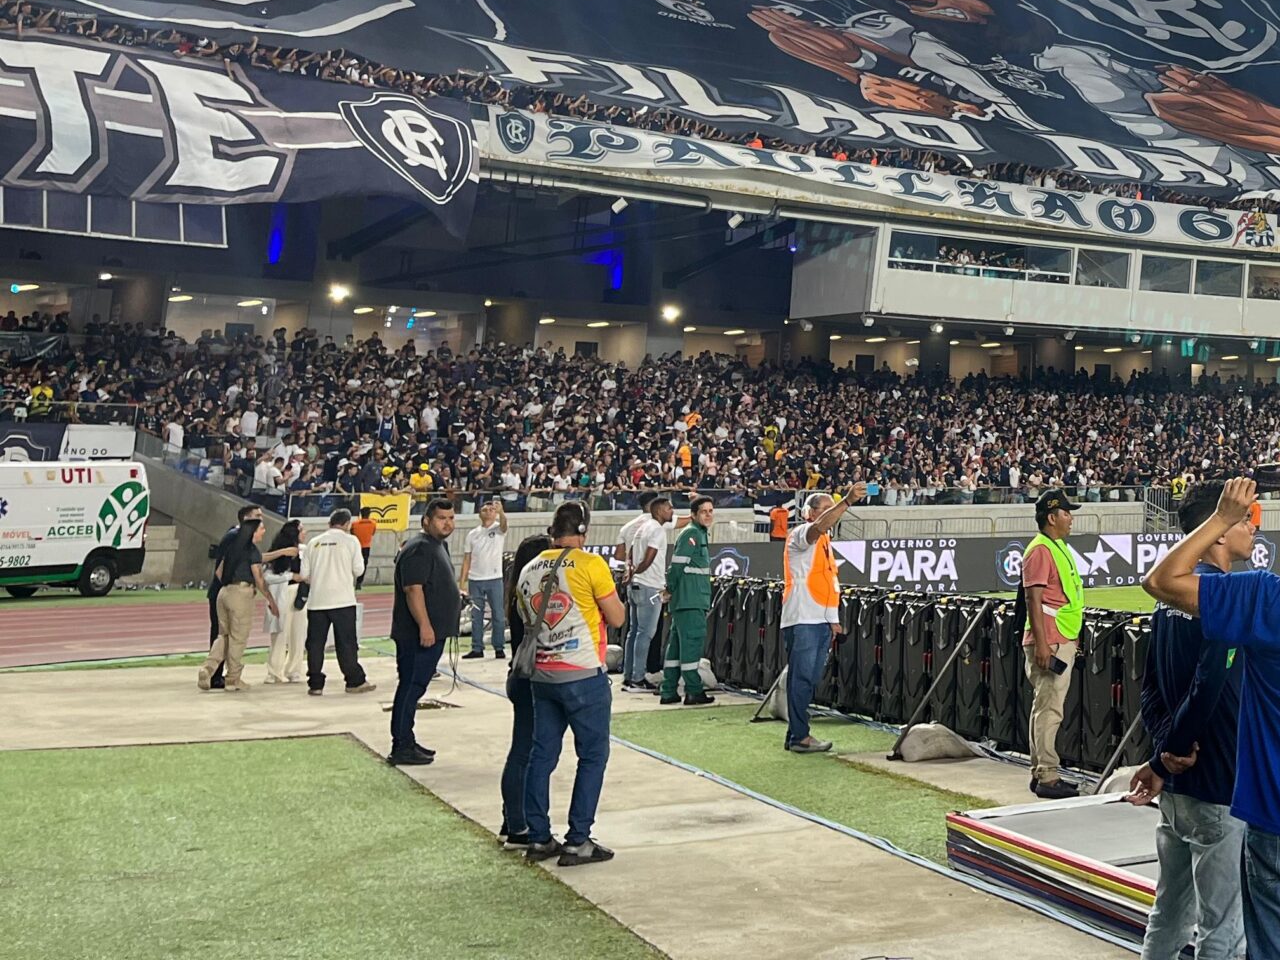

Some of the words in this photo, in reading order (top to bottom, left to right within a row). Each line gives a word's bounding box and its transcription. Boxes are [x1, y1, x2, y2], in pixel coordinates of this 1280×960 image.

[467, 37, 985, 152] FILHO
[1034, 133, 1240, 186] DA
[61, 468, 92, 484] UTI
[47, 525, 94, 537] ACCEB
[871, 539, 934, 548] GOVERNO
[939, 539, 957, 547] DO
[527, 558, 576, 573] IMPRESA
[870, 549, 959, 582] PARÁ
[1136, 543, 1170, 574] PA
